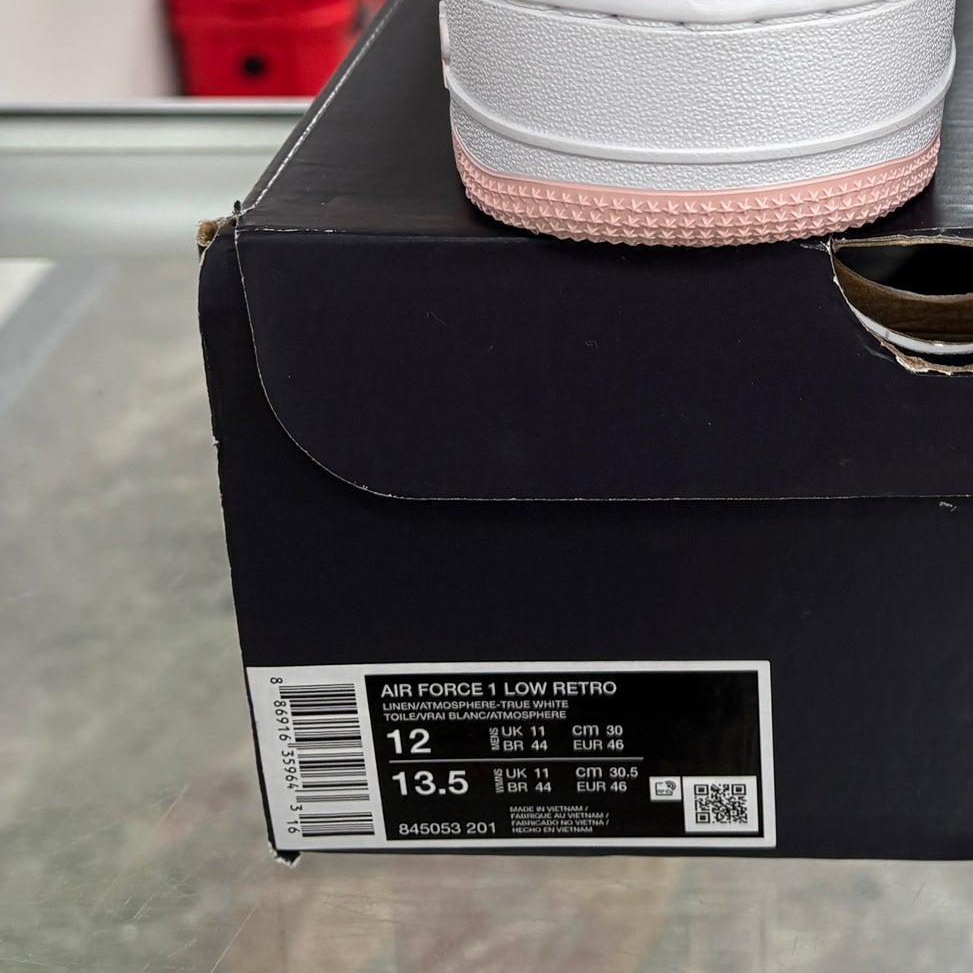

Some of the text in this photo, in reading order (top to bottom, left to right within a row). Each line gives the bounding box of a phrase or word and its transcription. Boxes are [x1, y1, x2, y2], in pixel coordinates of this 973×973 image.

[381, 681, 617, 698] AIR FORCE 1 LOW RETRO
[382, 700, 569, 711] LINEN/ATMOSPHERE-TRUE WHITE
[384, 710, 567, 722] TOILE/VRAI BLANC/ATMOSPHERE
[502, 726, 545, 737] UK 11
[606, 725, 623, 736] 30
[386, 728, 432, 754] 12
[503, 740, 548, 752] BR 44
[573, 739, 624, 751] EUR 46
[270, 676, 303, 834] 8 86916 35964 3 16
[506, 768, 549, 779] UK 11
[609, 767, 638, 778] 30.5
[392, 770, 469, 796] 13.5
[507, 782, 552, 793] BR 44
[576, 781, 627, 792] EUR 46
[399, 822, 496, 836] 845053 201
